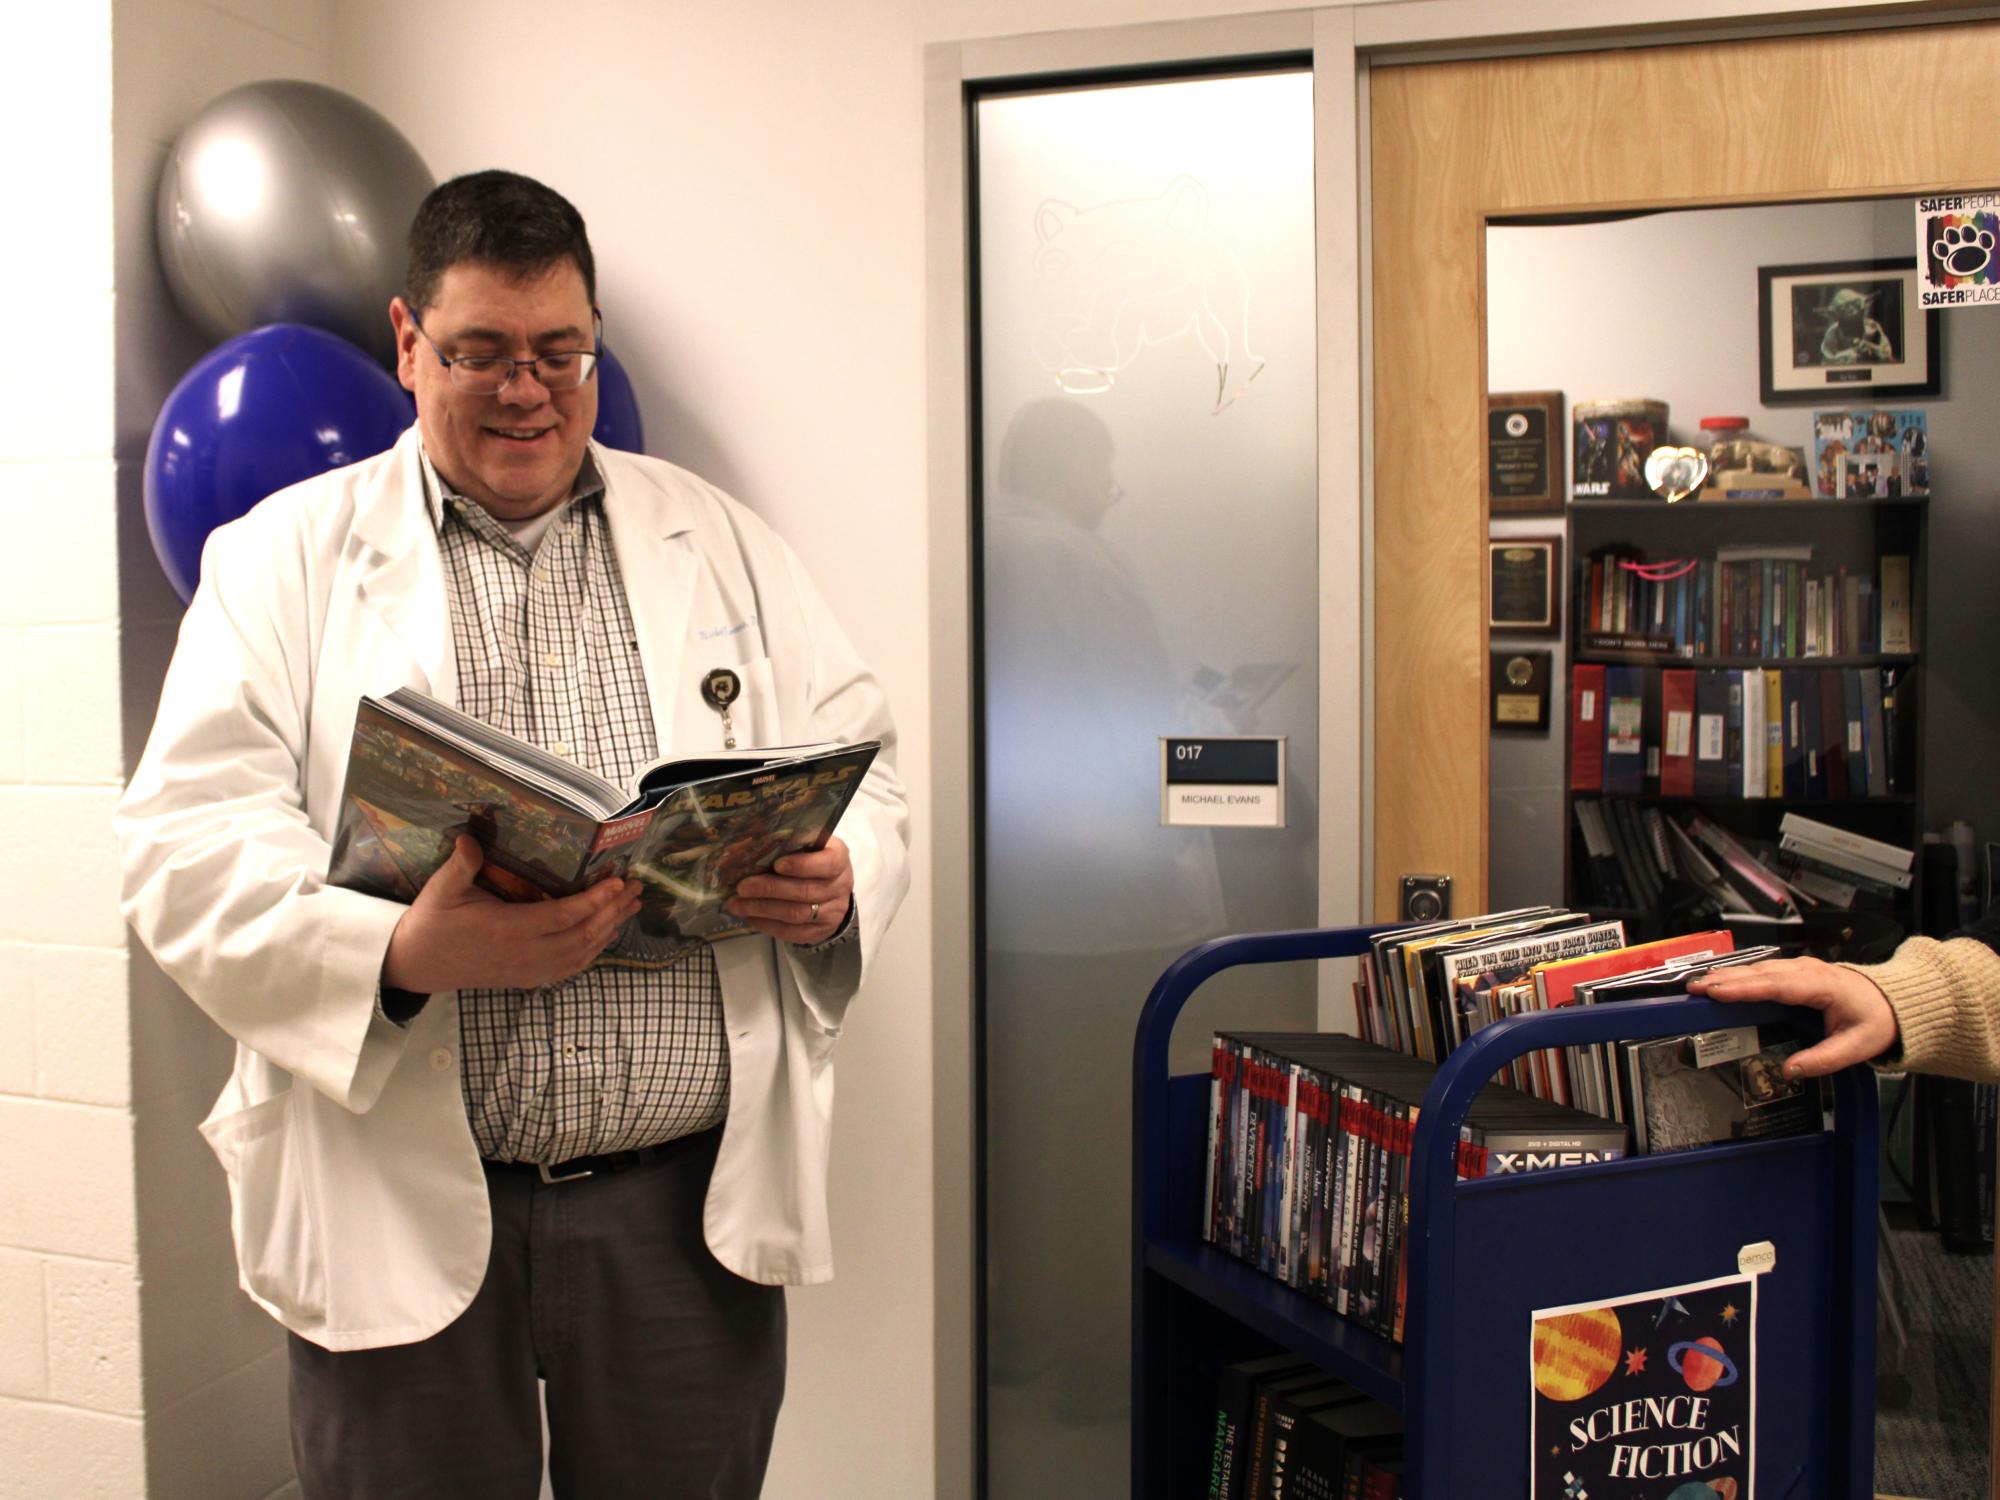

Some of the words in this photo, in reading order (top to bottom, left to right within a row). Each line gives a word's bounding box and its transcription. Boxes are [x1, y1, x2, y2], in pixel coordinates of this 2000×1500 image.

[1176, 745, 1203, 760] 017
[1181, 794, 1225, 805] MICHAEL
[1227, 794, 1261, 805] EVANS
[1247, 1111, 1257, 1195] DIVERGENT
[1225, 1424, 1236, 1446] THE
[1569, 1395, 1710, 1452] SCIENCE
[1608, 1424, 1741, 1479] FICTION
